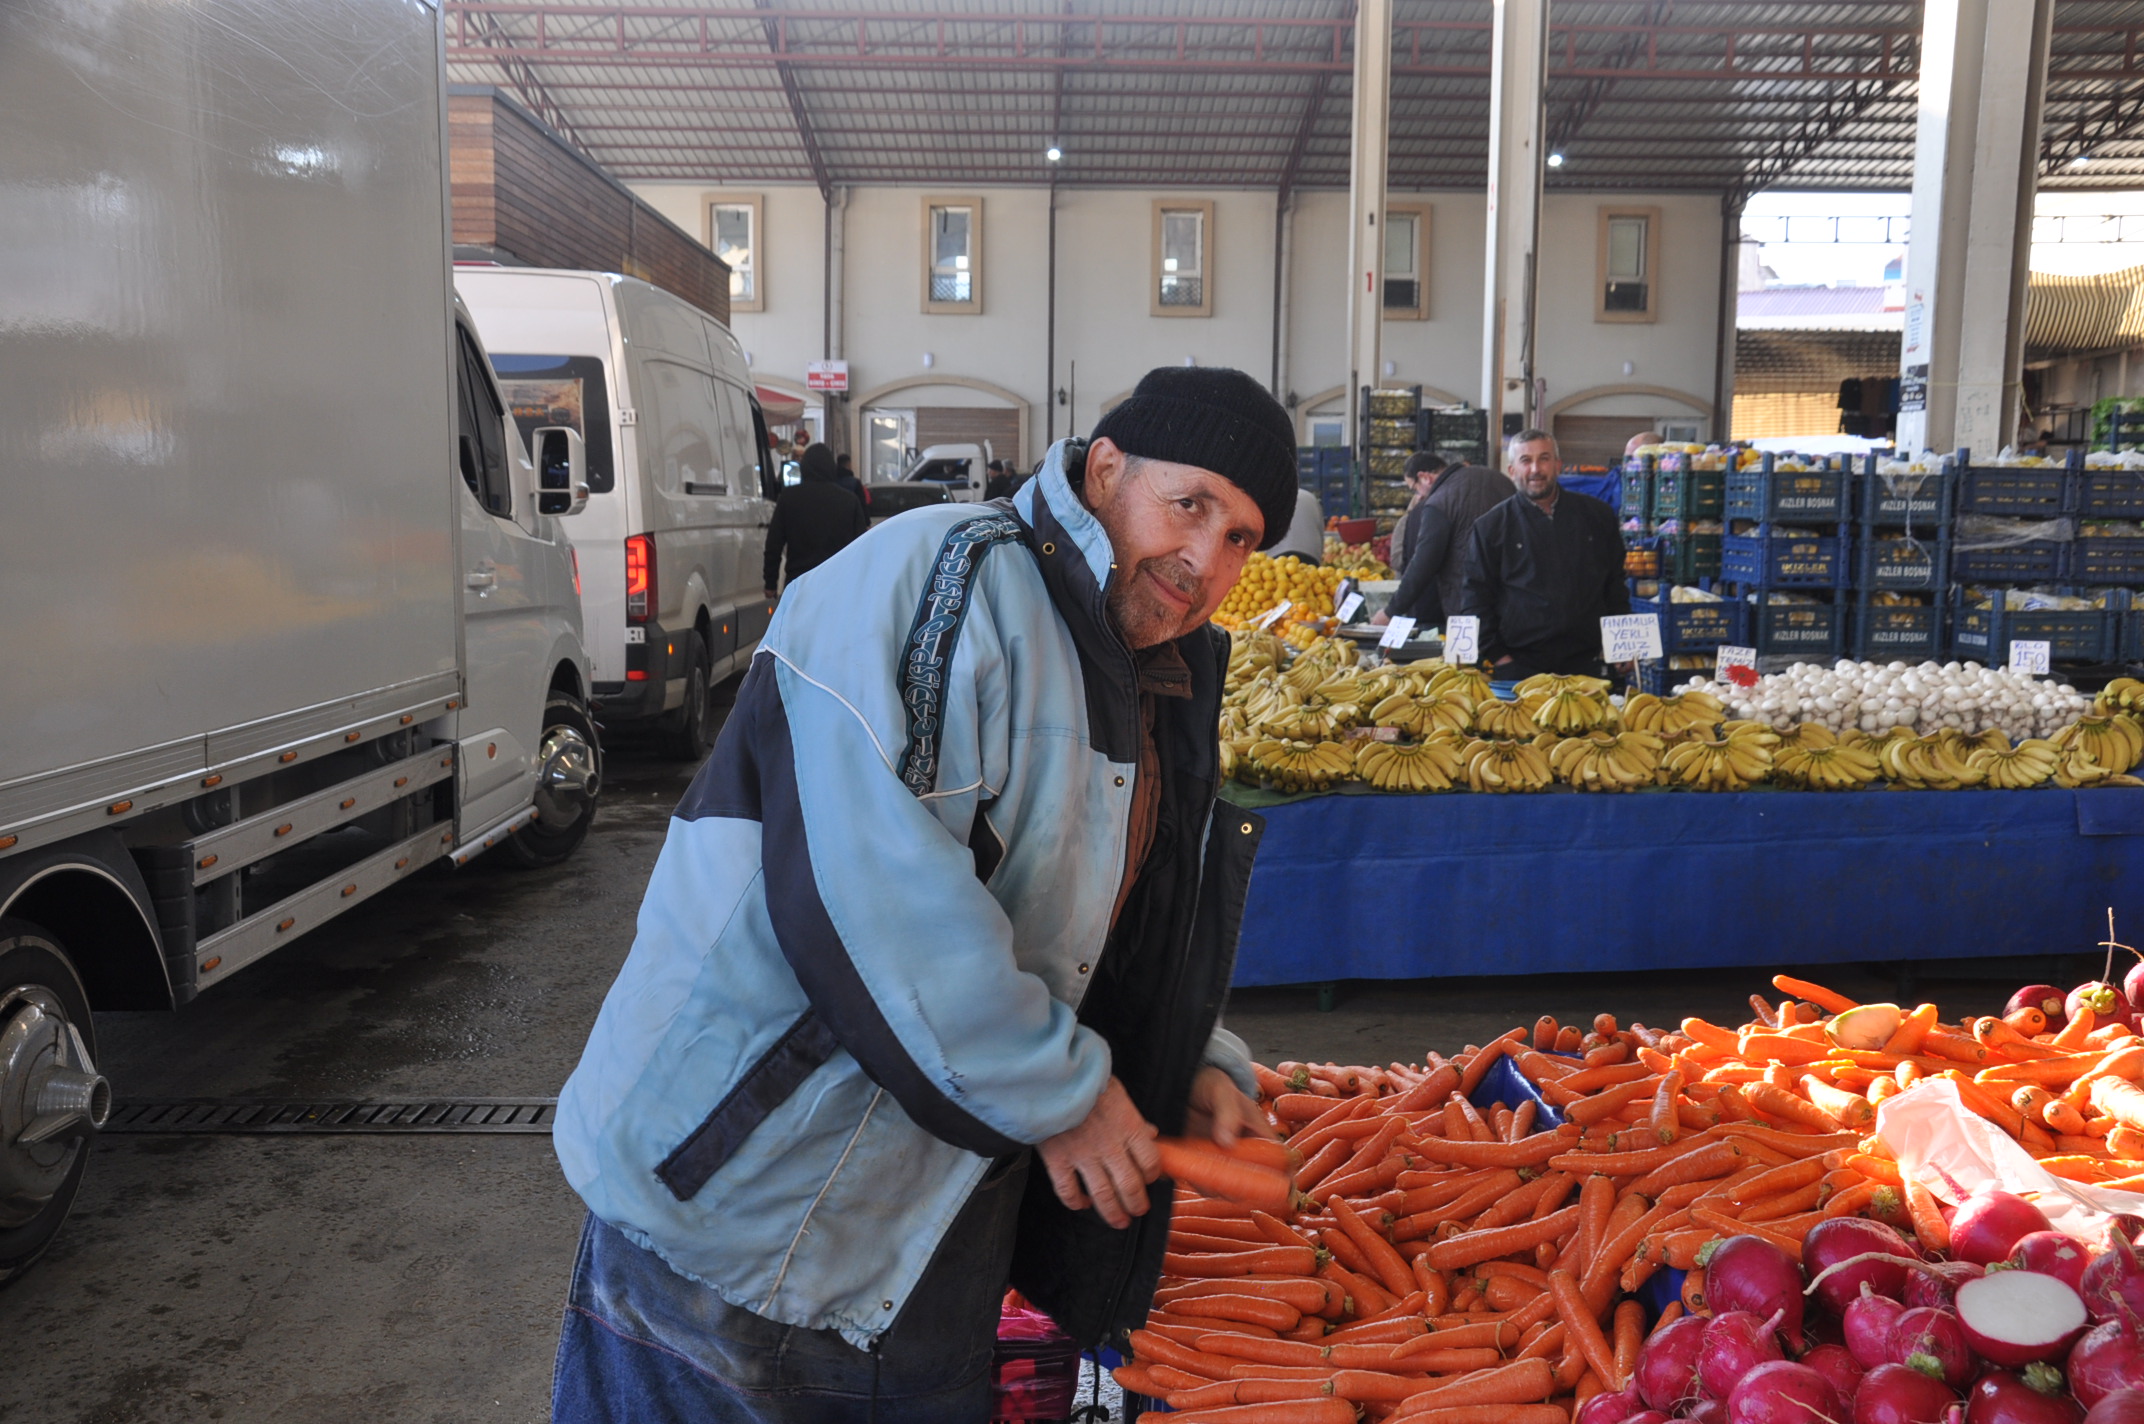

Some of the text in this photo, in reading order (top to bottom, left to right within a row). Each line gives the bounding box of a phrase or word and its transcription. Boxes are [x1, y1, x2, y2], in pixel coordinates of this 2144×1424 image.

[1603, 616, 1658, 628] ANAMUR
[1450, 625, 1473, 652] 75
[1612, 641, 1651, 652] MUZ
[1720, 646, 1753, 656] TAZE
[2013, 651, 2046, 667] 150
[905, 647, 943, 713] asics
